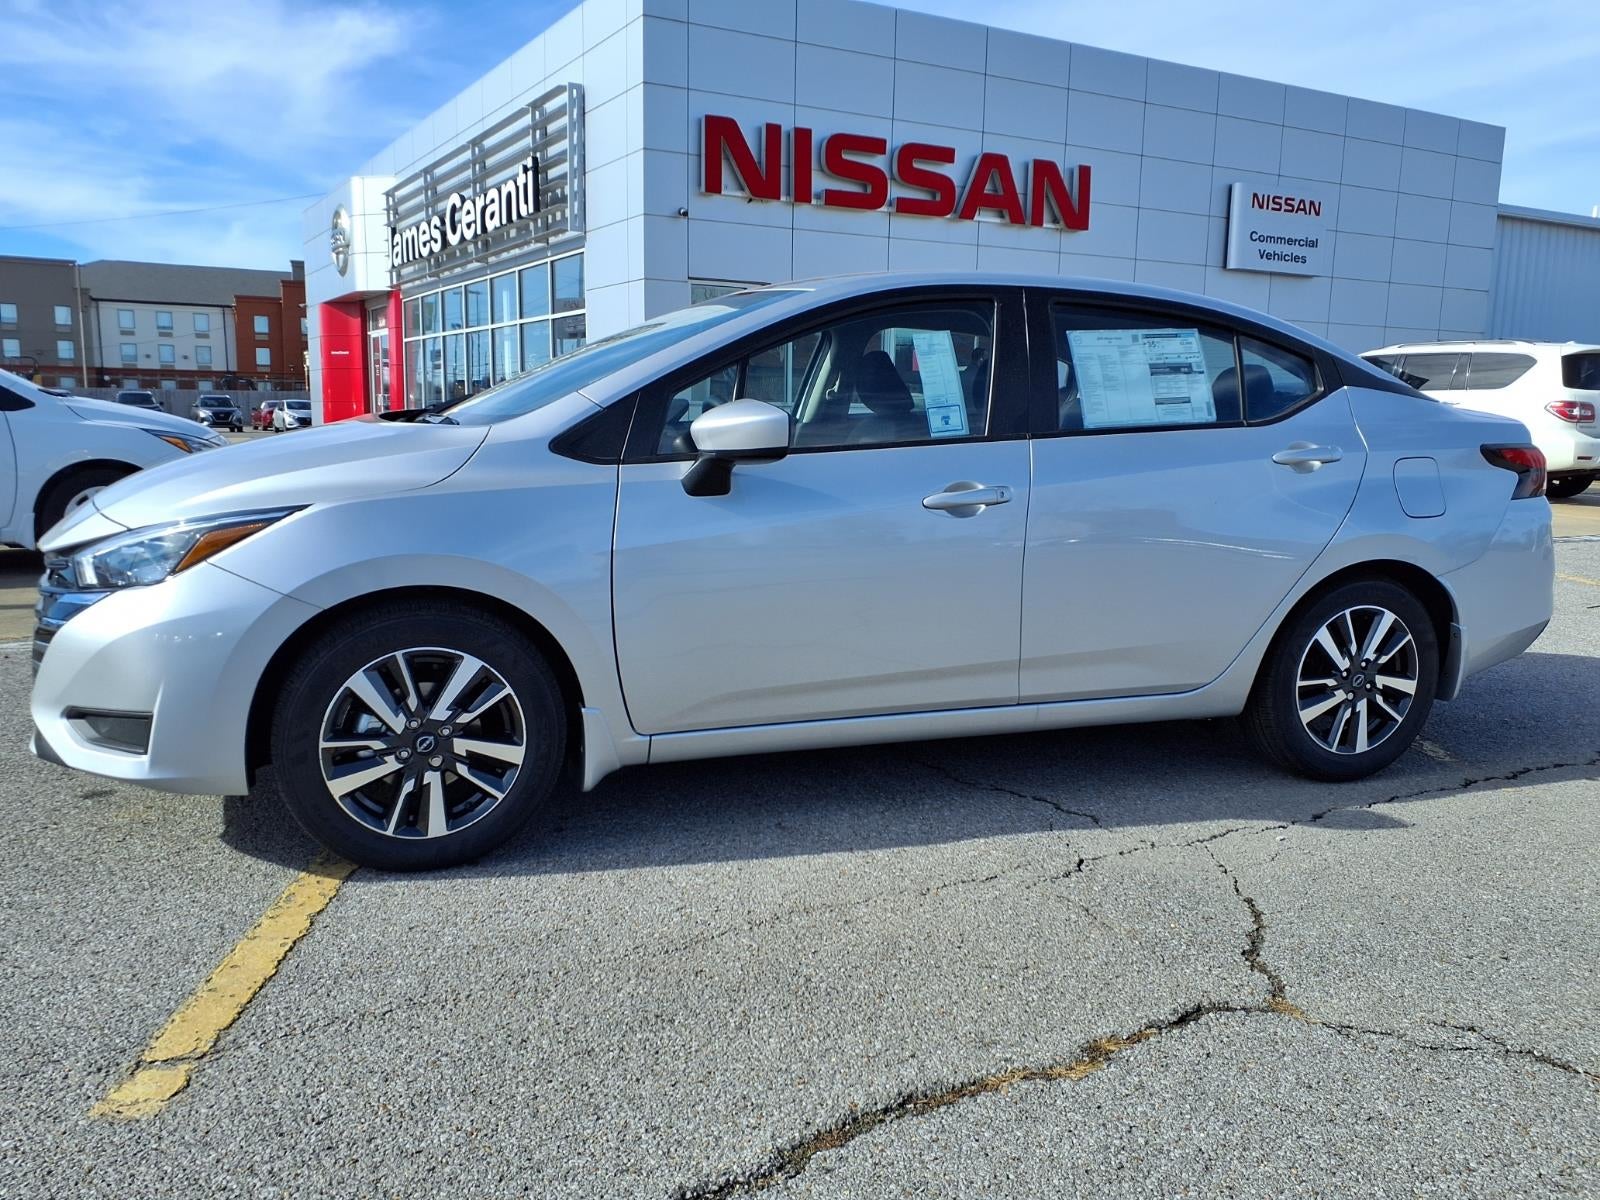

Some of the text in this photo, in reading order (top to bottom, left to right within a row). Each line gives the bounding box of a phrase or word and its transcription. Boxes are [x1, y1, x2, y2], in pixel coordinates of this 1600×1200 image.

[702, 114, 1091, 231] NISSAN
[445, 155, 538, 246] Ceranti
[1251, 192, 1322, 217] NISSAN
[1249, 230, 1319, 249] Commercial
[1258, 248, 1308, 264] Vehicles
